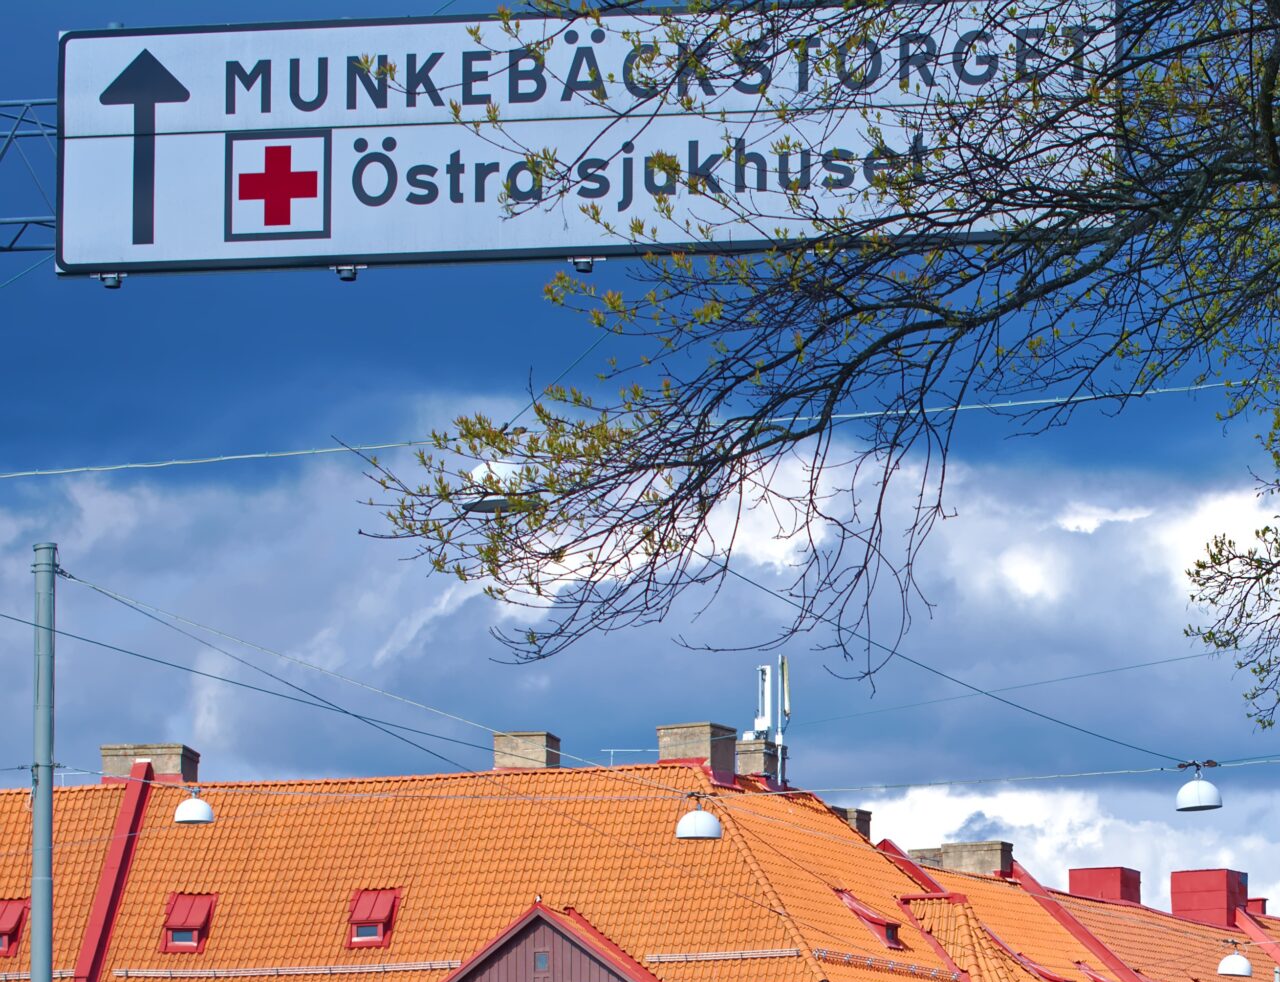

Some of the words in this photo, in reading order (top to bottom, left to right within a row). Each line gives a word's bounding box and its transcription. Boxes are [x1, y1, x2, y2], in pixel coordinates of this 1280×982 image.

[225, 25, 1096, 115] MUNKEBÄCKSTORGET
[352, 136, 543, 207] Östra
[577, 132, 928, 212] sjukhuset
